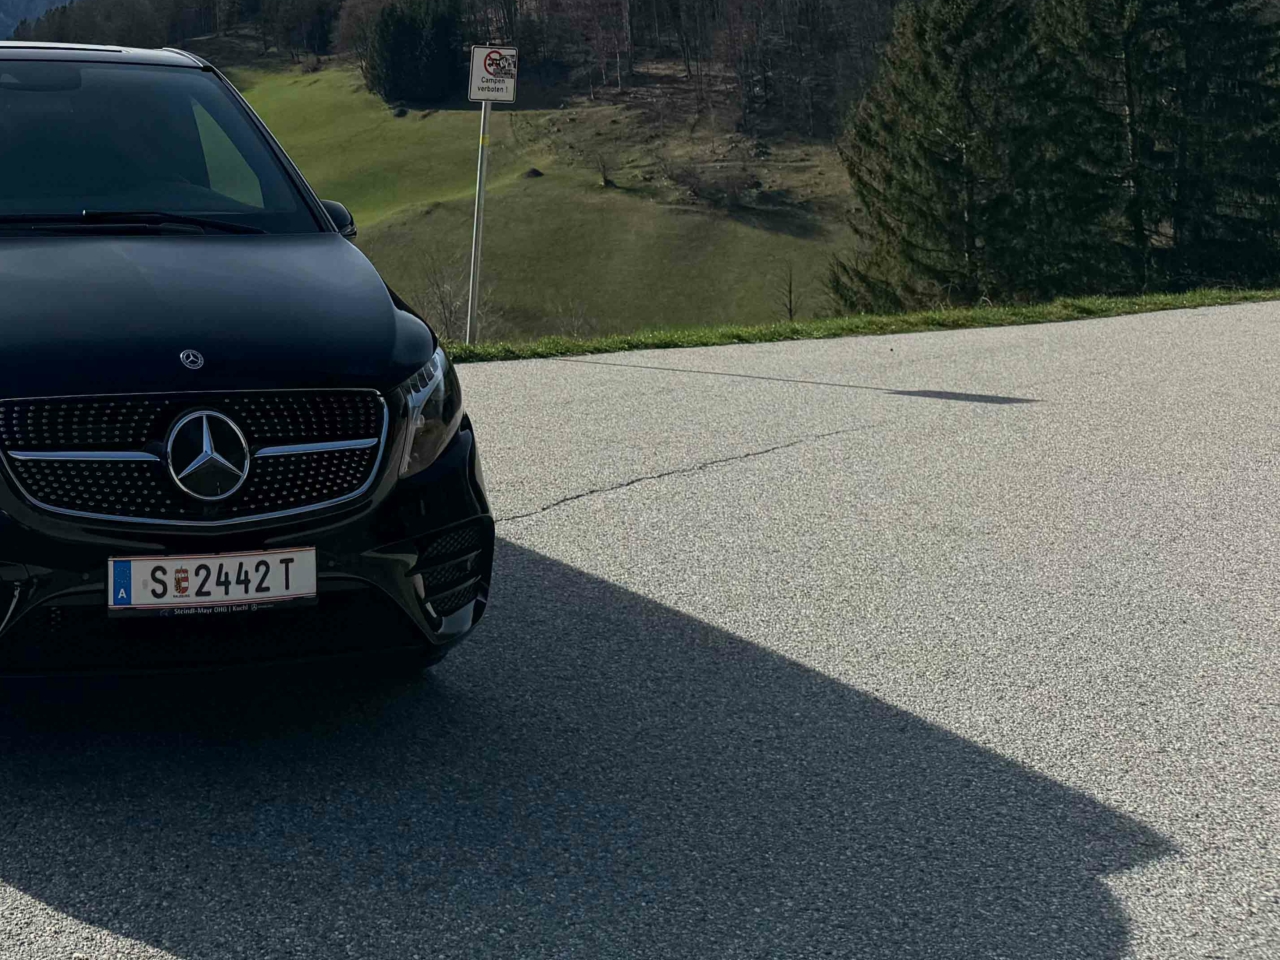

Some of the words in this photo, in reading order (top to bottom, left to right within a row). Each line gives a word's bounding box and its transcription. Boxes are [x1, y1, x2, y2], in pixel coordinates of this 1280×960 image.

[481, 76, 505, 84] Campen
[150, 565, 168, 599] S
[118, 589, 127, 599] A
